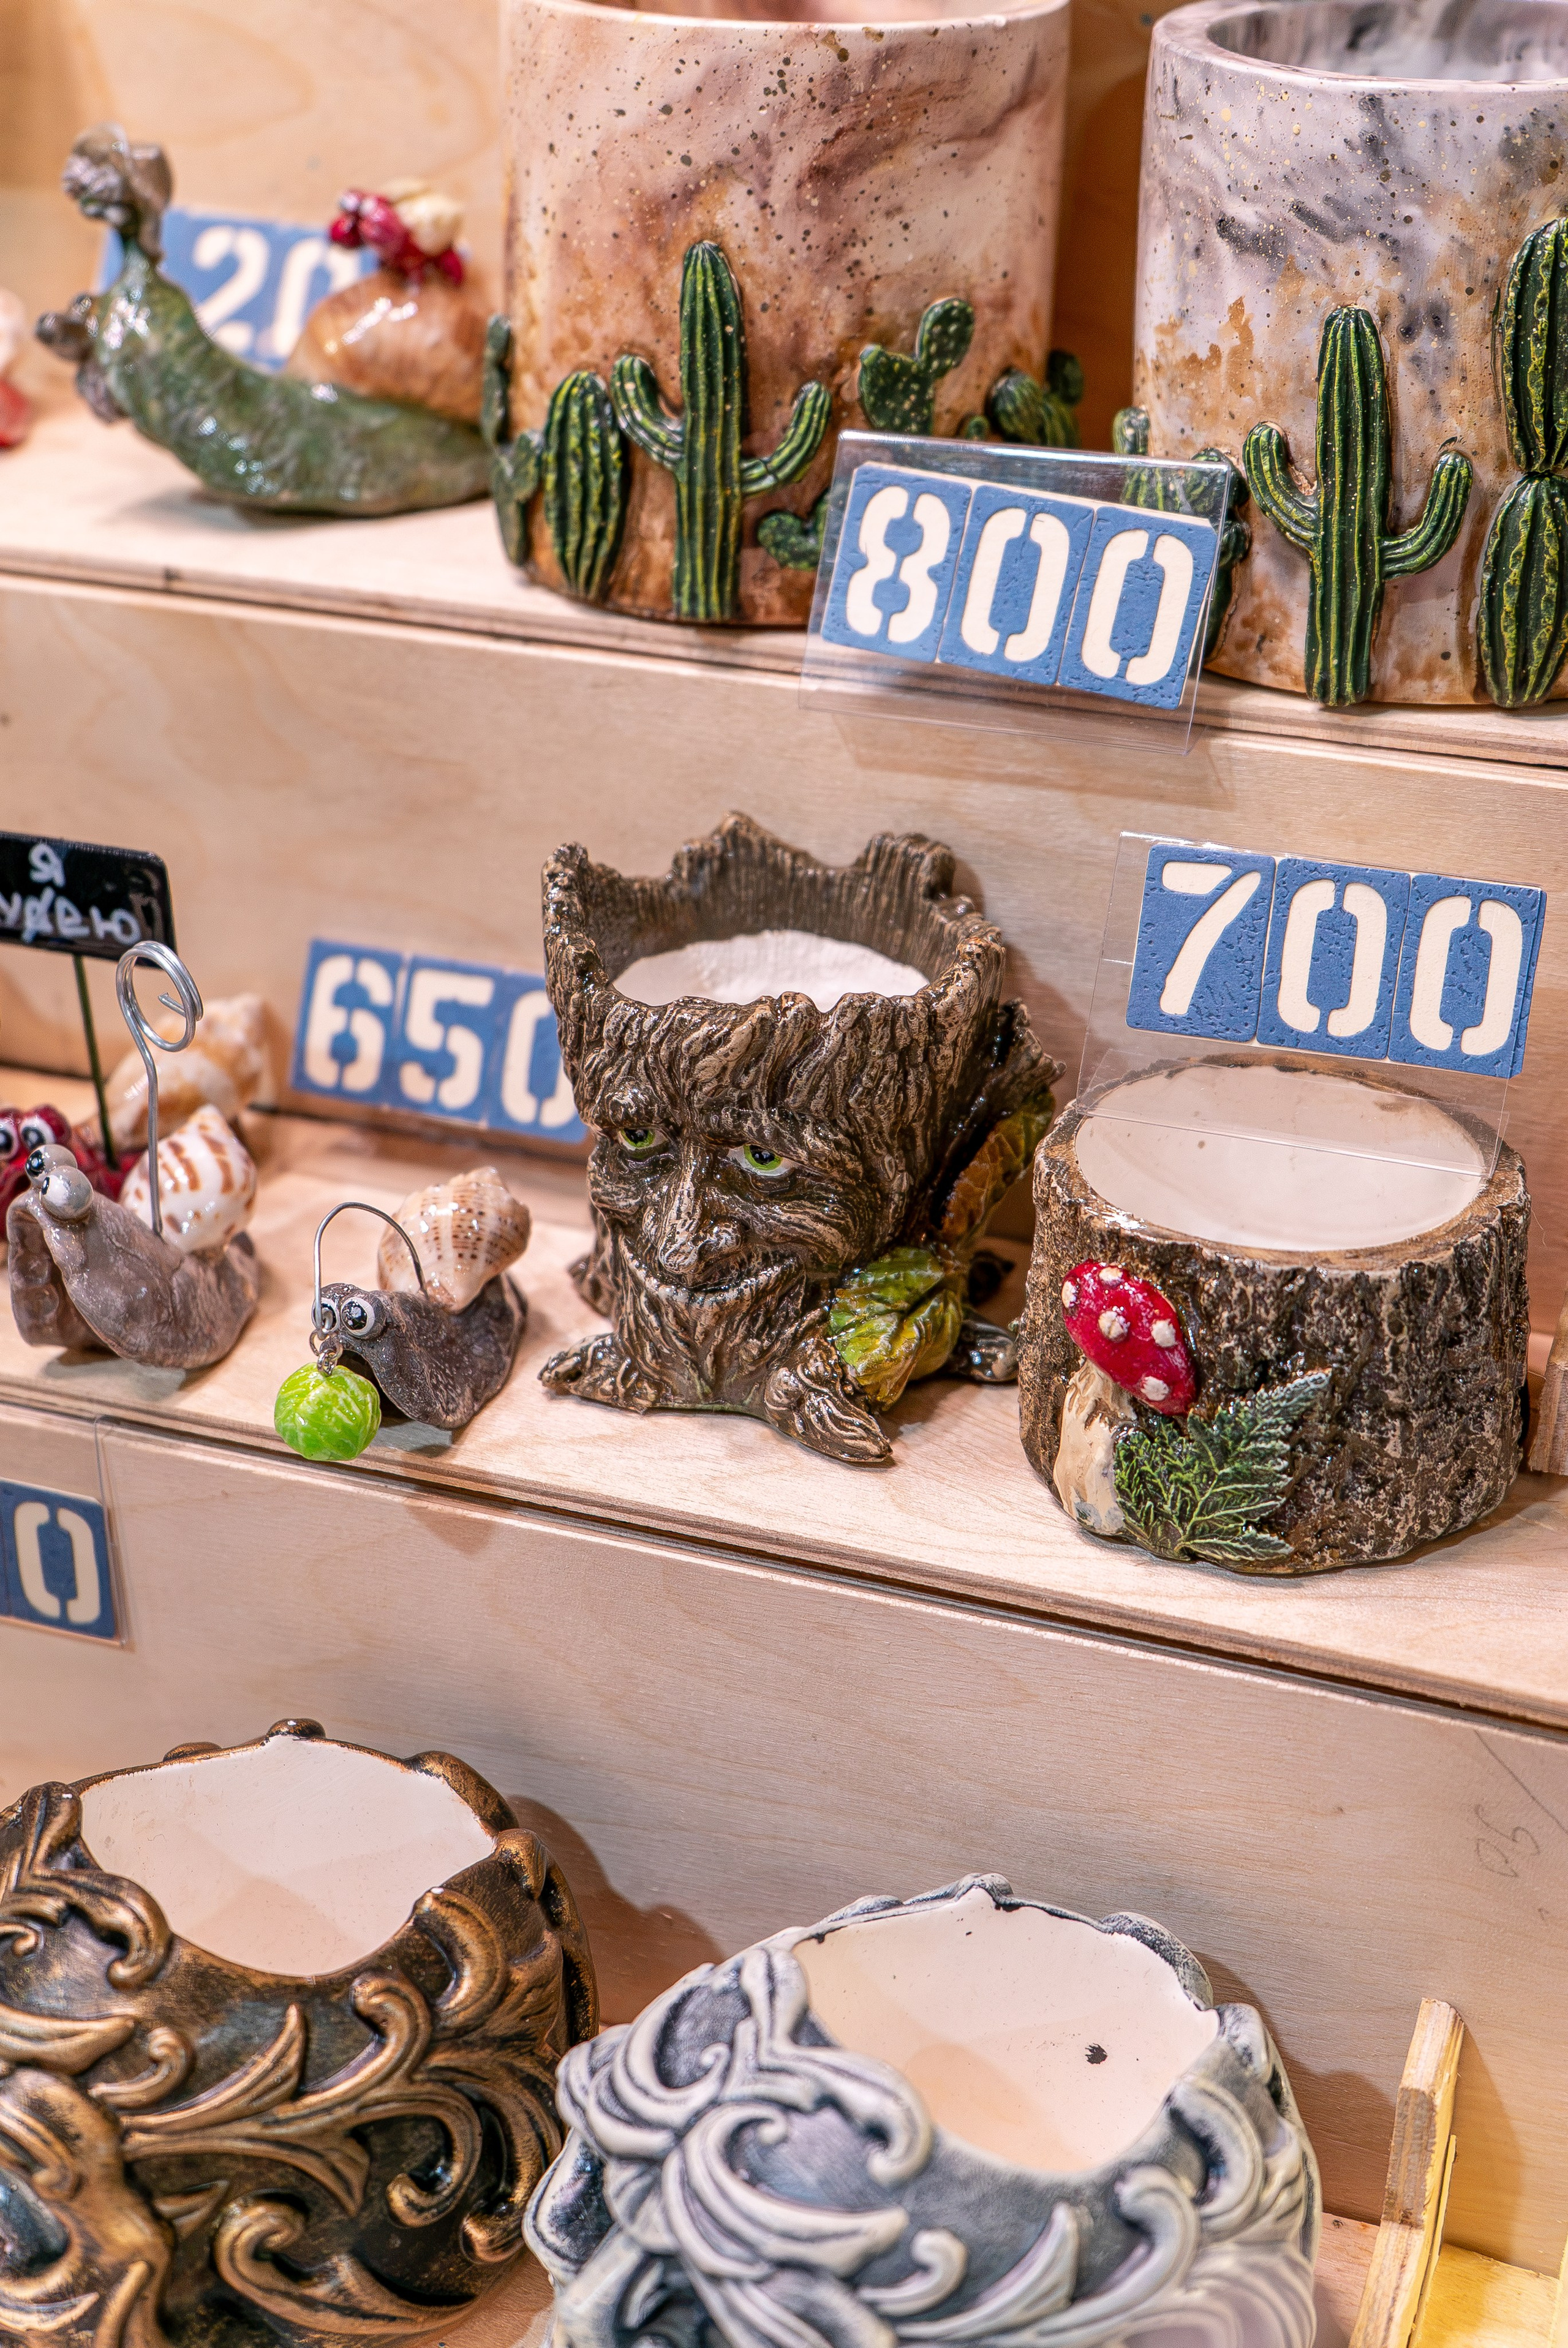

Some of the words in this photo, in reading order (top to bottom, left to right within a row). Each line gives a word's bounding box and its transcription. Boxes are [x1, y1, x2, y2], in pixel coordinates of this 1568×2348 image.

[846, 486, 1193, 685] 800
[304, 954, 576, 1128] 650
[1160, 861, 1523, 1056] 700
